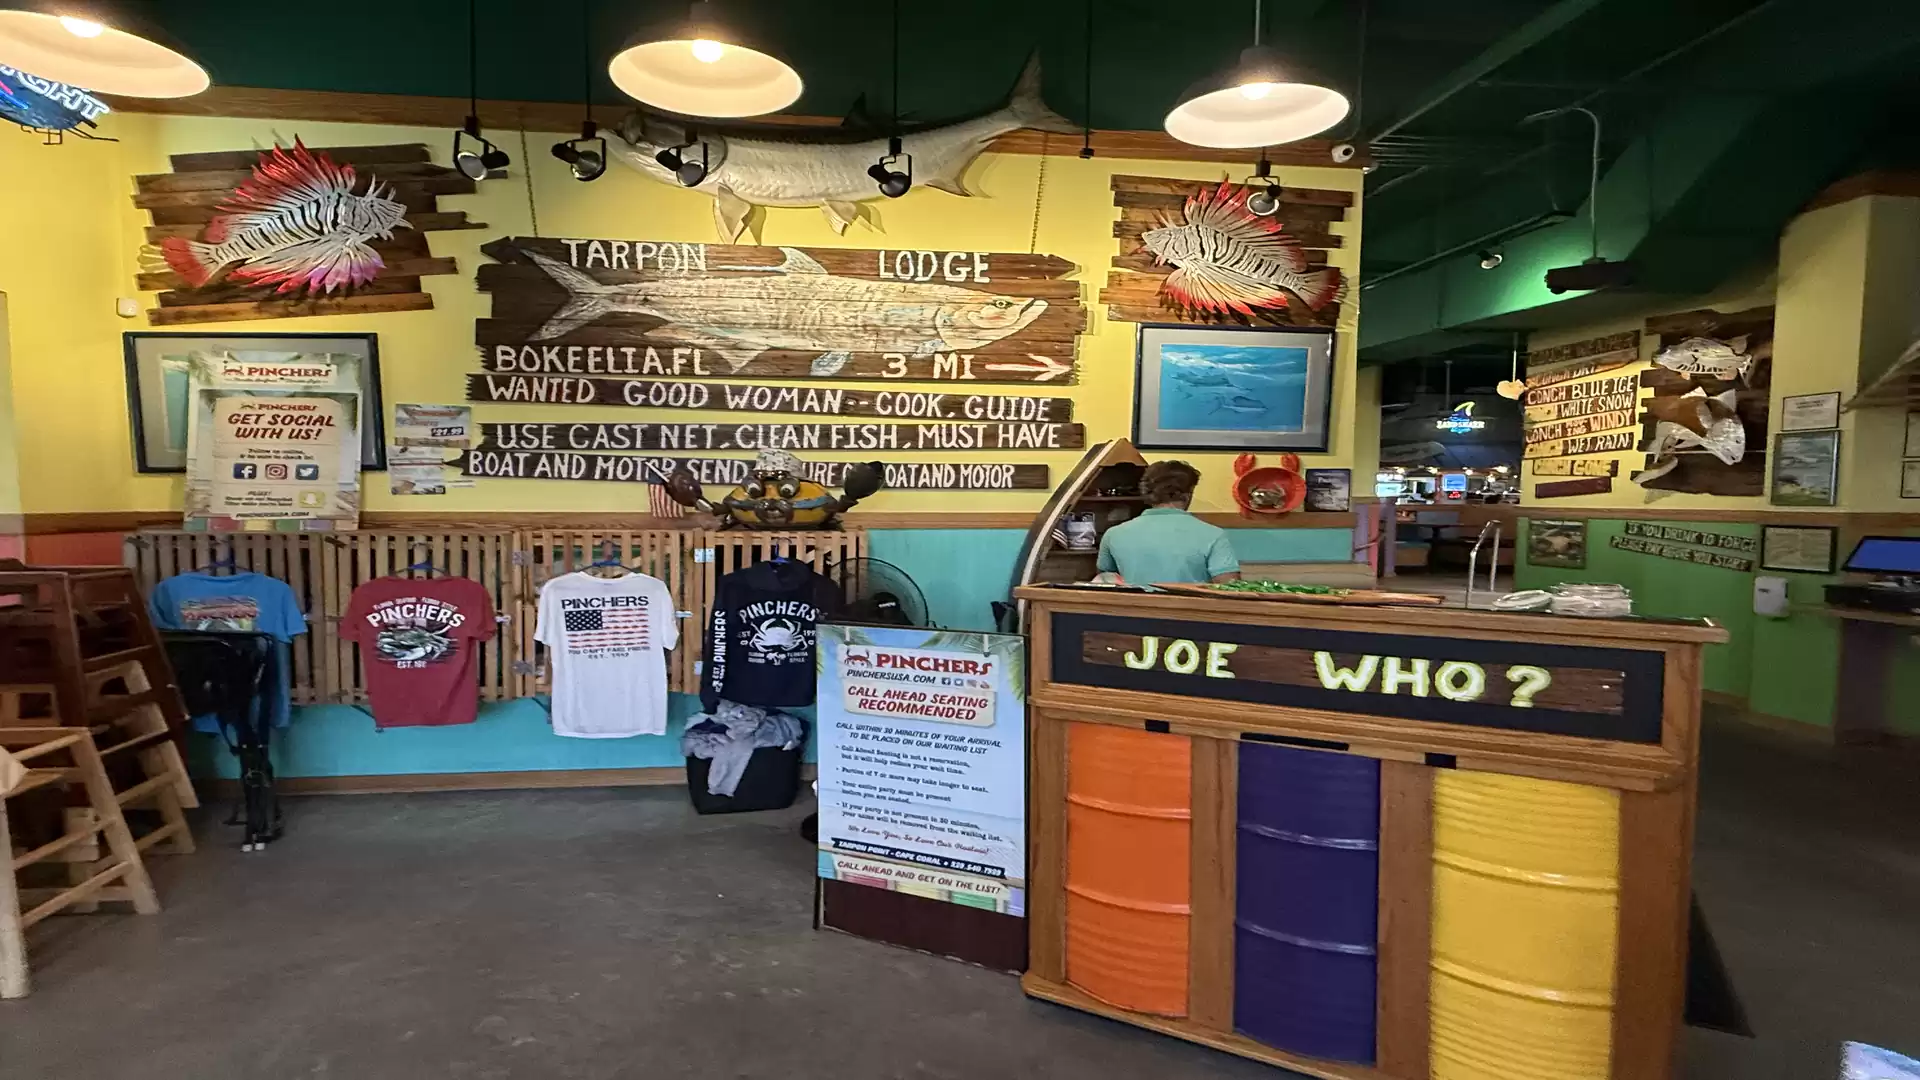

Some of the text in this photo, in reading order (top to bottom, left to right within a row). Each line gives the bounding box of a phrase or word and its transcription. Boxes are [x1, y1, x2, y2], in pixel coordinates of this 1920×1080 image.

[560, 239, 990, 283] TARPON LODGE
[247, 367, 331, 377] PINCHERS
[881, 352, 907, 378] 3
[932, 354, 975, 380] MI
[486, 376, 1052, 422] WANTED GOOD WOMAN COOK, GUIDE
[1527, 375, 1634, 405] CONCH BLUE ICE
[258, 403, 318, 411] PINCHERS
[1560, 400, 1593, 418] WHITE
[1597, 393, 1634, 412] SNOW
[228, 413, 336, 427] GET SOCIAL
[1526, 424, 1562, 443] CONCH
[1590, 409, 1633, 431] WINDY
[235, 427, 323, 440] WITH US!
[497, 424, 556, 449] USE
[569, 424, 649, 450] CAST
[735, 424, 819, 450] CLEAN
[831, 424, 912, 450] FISH,
[918, 424, 987, 449] MUST
[998, 424, 1062, 449] HAVE
[1568, 437, 1591, 454] WET
[1595, 433, 1629, 451] RAIN
[469, 451, 530, 476] BOAT
[534, 454, 586, 479] AND
[686, 459, 749, 484] SEND
[883, 464, 915, 488] OAT
[959, 464, 1016, 489] MOTOR
[1642, 524, 1662, 538] YOU
[1664, 529, 1697, 543] DRINK
[1701, 532, 1715, 545] TO
[1612, 536, 1644, 552] PLEASE
[1646, 542, 1662, 555] PAY
[1694, 551, 1712, 564] YOU
[561, 596, 649, 609] PINCHERS
[739, 600, 819, 624] PINCHERS
[366, 604, 466, 627] PINCHERS
[713, 610, 726, 662] PINCHERS
[876, 653, 993, 676] PINCHERS
[1124, 635, 1239, 679] JOE
[847, 669, 936, 684] PINCHERSUSA.COM
[848, 686, 988, 708] CALL AHEAD SEATING
[858, 699, 976, 720] RECOMMENDED
[836, 722, 1002, 748] CALL WITHIN 30 MINUTES OF YOUR ARRIVAL
[872, 735, 900, 744] PLACED
[934, 741, 968, 752] WAITING
[970, 746, 987, 755] LIST
[874, 757, 887, 766] help
[913, 762, 929, 771] your
[876, 749, 900, 759] Seating
[842, 780, 856, 788] Your
[878, 785, 896, 794] party
[907, 776, 920, 785] may
[939, 780, 960, 789] longer
[850, 804, 863, 812] your
[865, 806, 881, 816] party
[904, 812, 929, 822] present
[842, 812, 855, 820] your
[877, 815, 889, 823] will
[900, 819, 928, 830] removed
[930, 824, 945, 833] from
[947, 827, 958, 835] the
[961, 829, 986, 841] waiting
[868, 846, 890, 855] POINT
[895, 850, 915, 861] CAPE
[916, 854, 941, 865] CORAL
[837, 861, 1000, 894] CALL AHEAD AND GET ON THE LIST!
